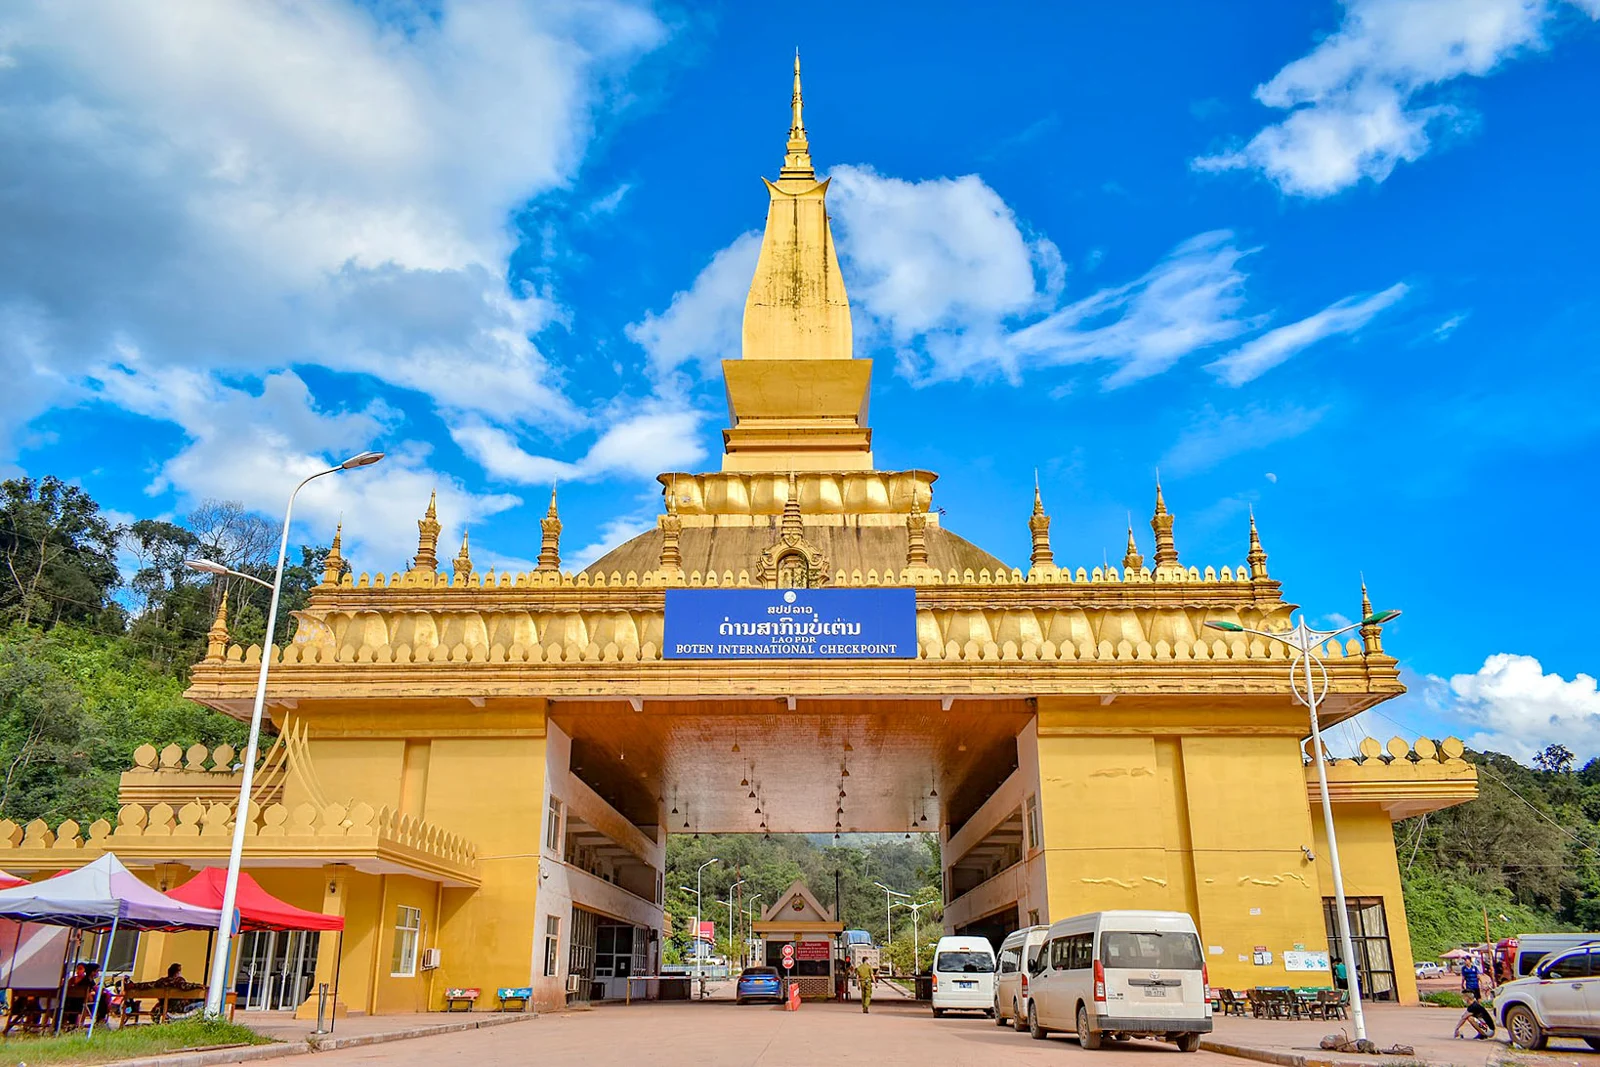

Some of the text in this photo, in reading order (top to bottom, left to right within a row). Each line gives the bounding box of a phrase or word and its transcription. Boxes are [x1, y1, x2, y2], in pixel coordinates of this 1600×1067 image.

[771, 636, 816, 644] LAO PDR
[676, 644, 897, 654] BOTEN INTERNATIONAL CHECKPOINT
